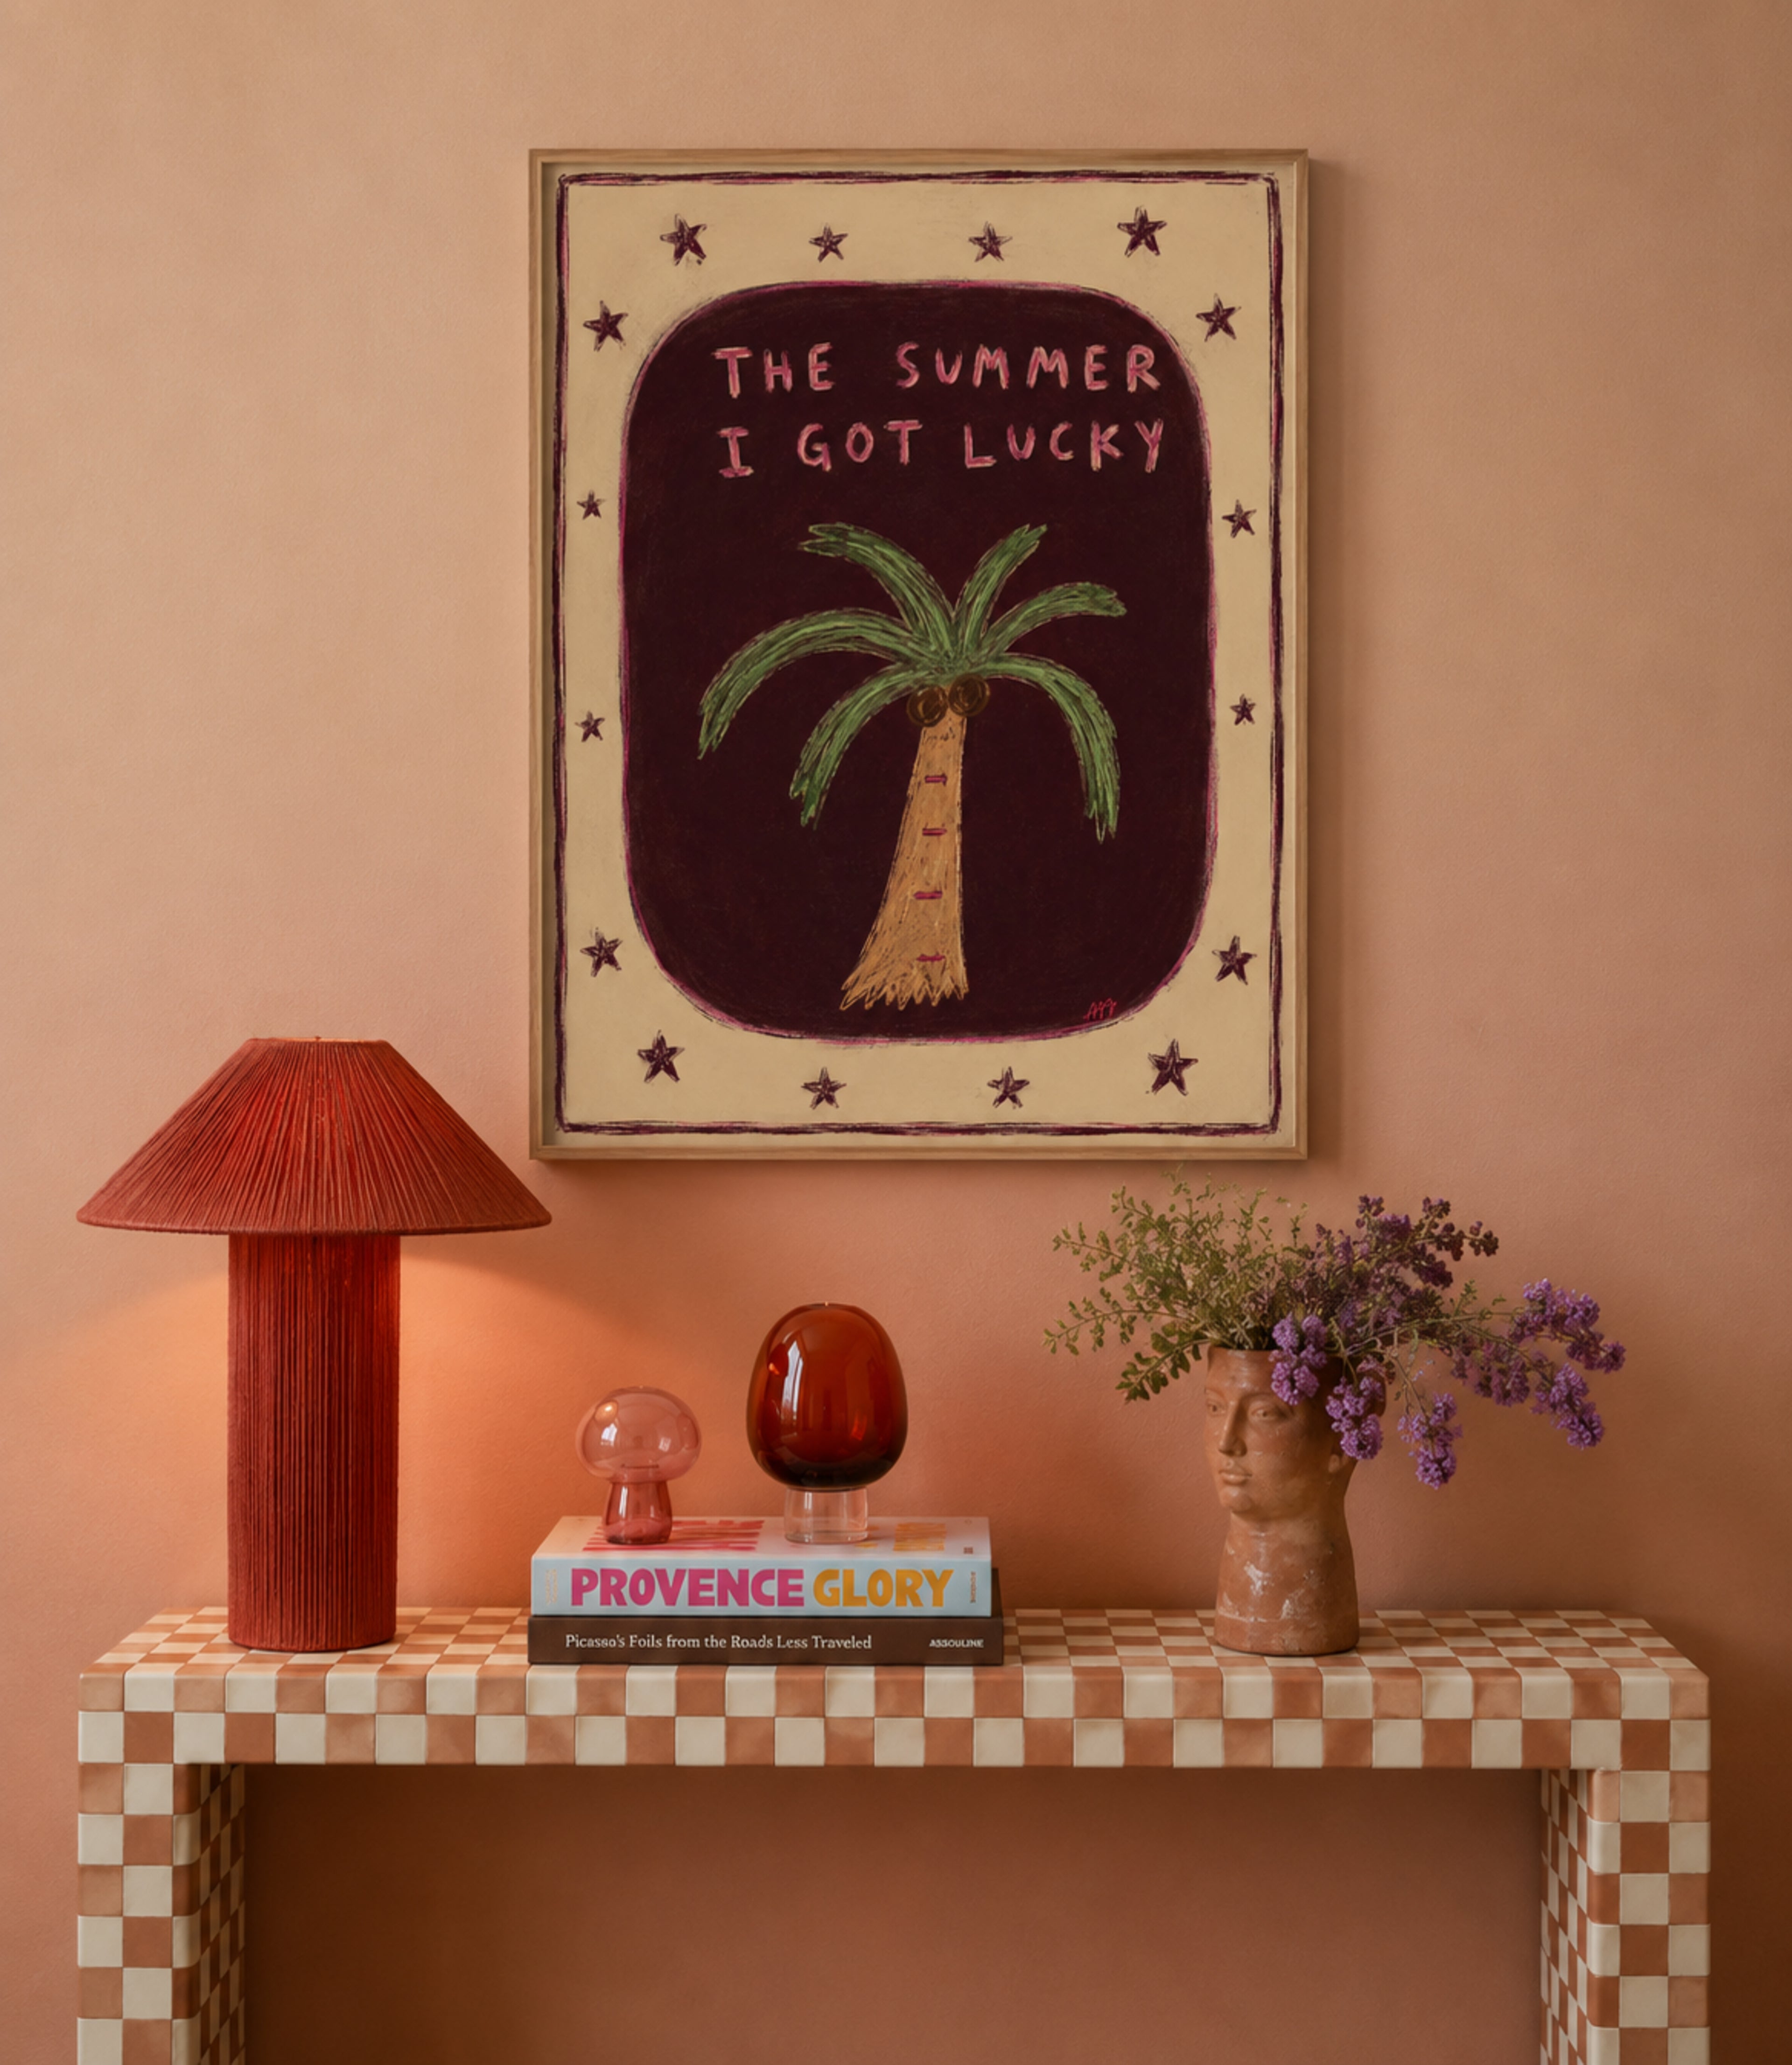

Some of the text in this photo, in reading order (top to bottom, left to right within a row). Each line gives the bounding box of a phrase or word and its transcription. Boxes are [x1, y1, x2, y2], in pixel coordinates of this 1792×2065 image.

[712, 342, 1161, 399] THE SUMMER
[717, 420, 1163, 478] I GOT LUCKY
[571, 1568, 804, 1606] PROVENCE
[813, 1569, 954, 1607] GLORY
[630, 1634, 663, 1648] Foils
[666, 1634, 700, 1648] from
[704, 1635, 727, 1648] the
[731, 1635, 774, 1648] Roads
[777, 1635, 808, 1649] Less
[811, 1635, 872, 1649] Traveled
[929, 1638, 984, 1648] ASSOULINE
